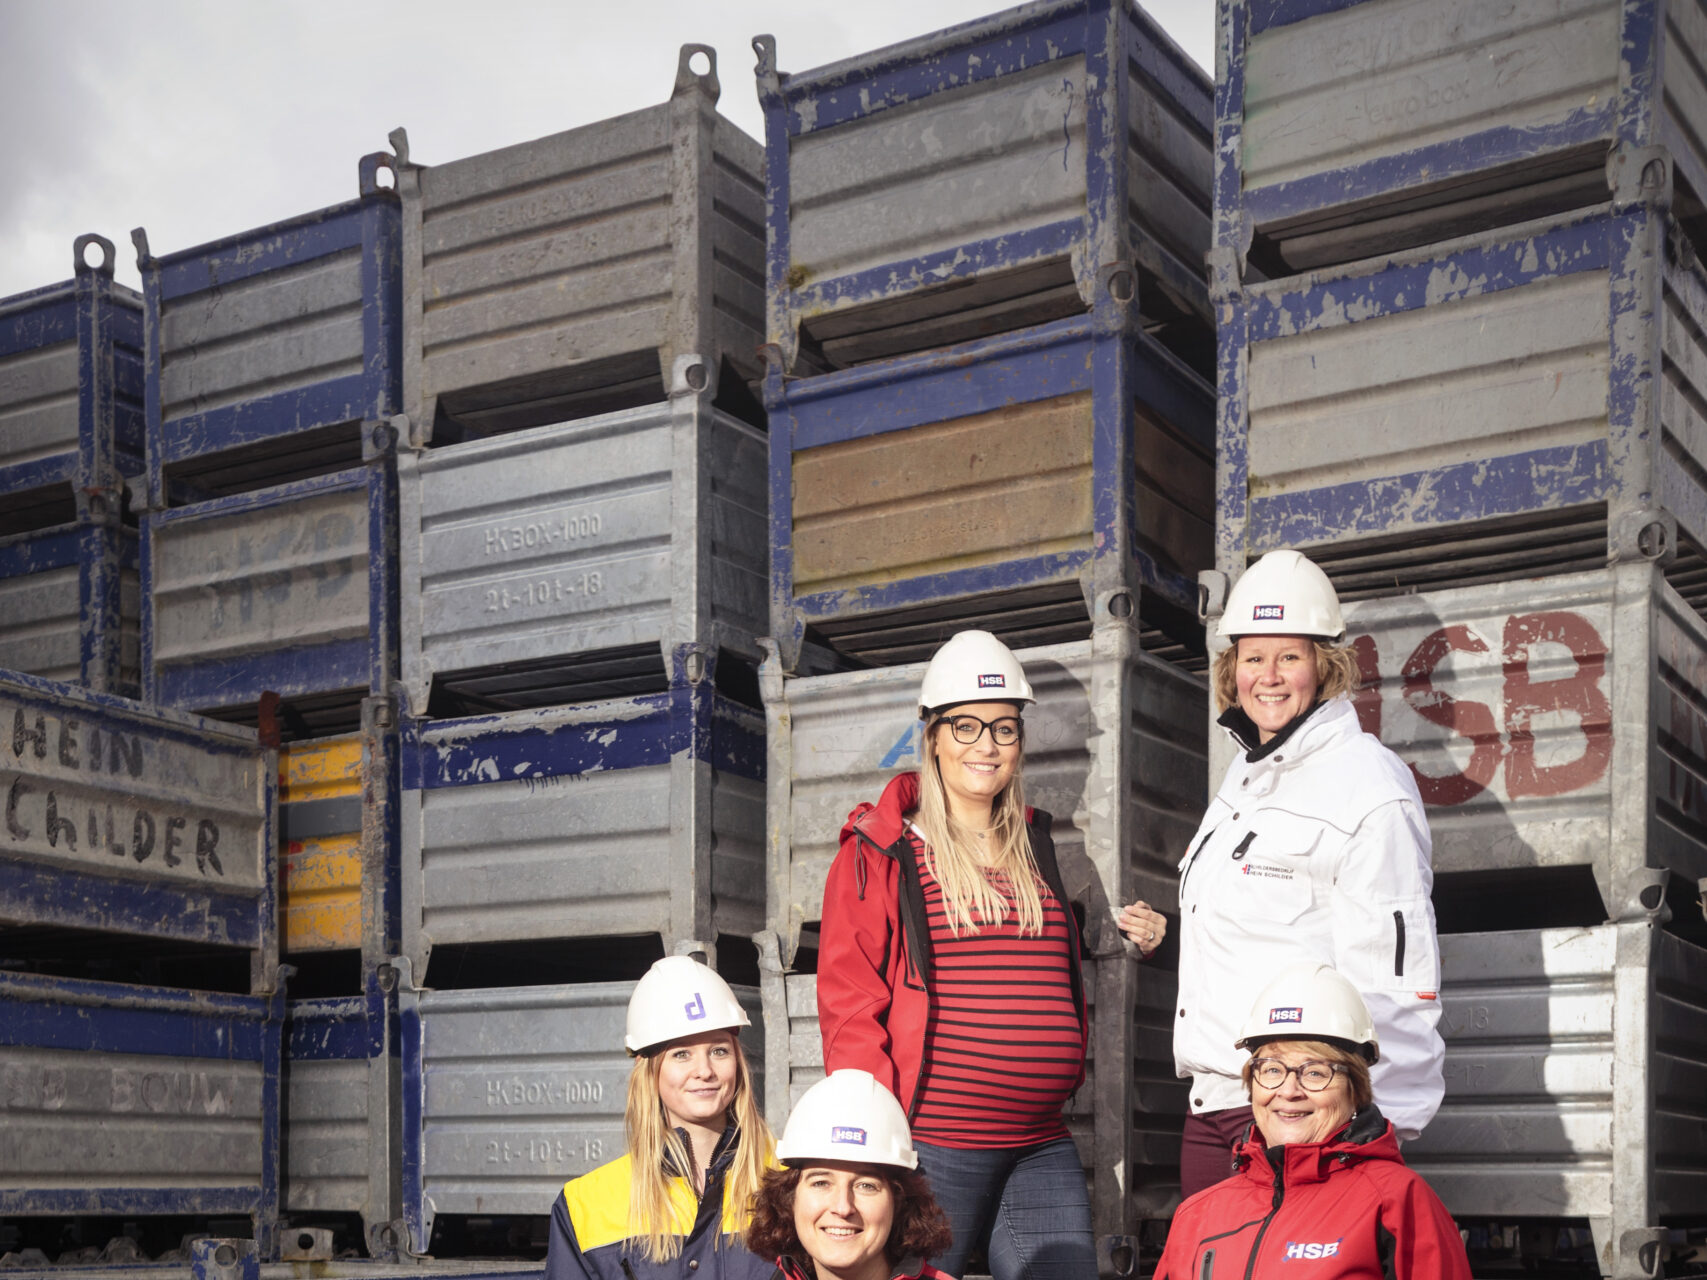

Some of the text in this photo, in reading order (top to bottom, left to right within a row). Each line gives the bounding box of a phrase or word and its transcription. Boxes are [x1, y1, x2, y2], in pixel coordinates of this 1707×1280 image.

[1256, 607, 1281, 618] HSB
[980, 676, 1003, 685] HSB
[12, 707, 144, 779] HEIN
[1272, 1010, 1299, 1021] HSB
[111, 1069, 238, 1116] BOUW
[836, 1130, 863, 1141] HSB
[1287, 1242, 1340, 1260] HSB
